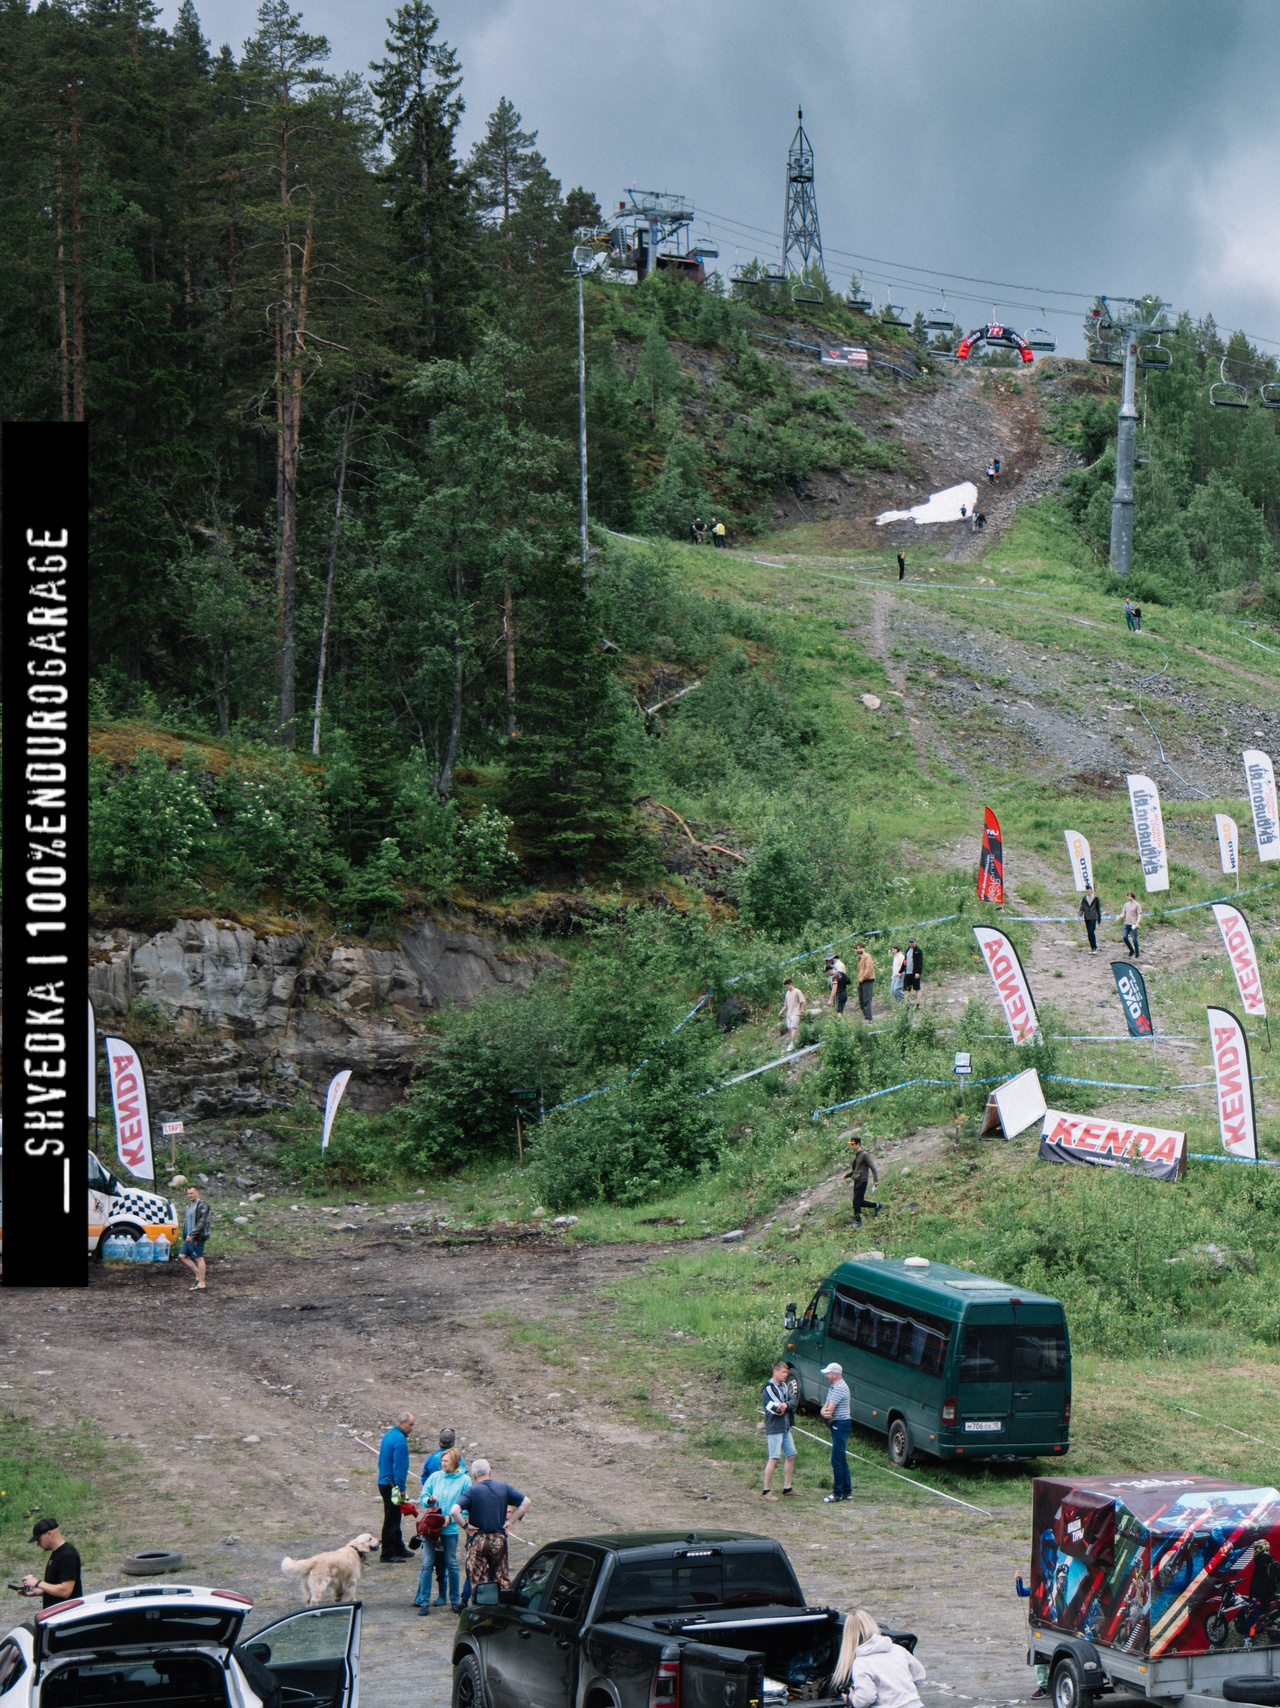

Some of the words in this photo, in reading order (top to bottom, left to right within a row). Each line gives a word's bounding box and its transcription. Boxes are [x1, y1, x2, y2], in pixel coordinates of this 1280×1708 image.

[1130, 344, 1137, 354] 3
[165, 1123, 182, 1133] СТАРТ
[1046, 1117, 1178, 1165] KENDA
